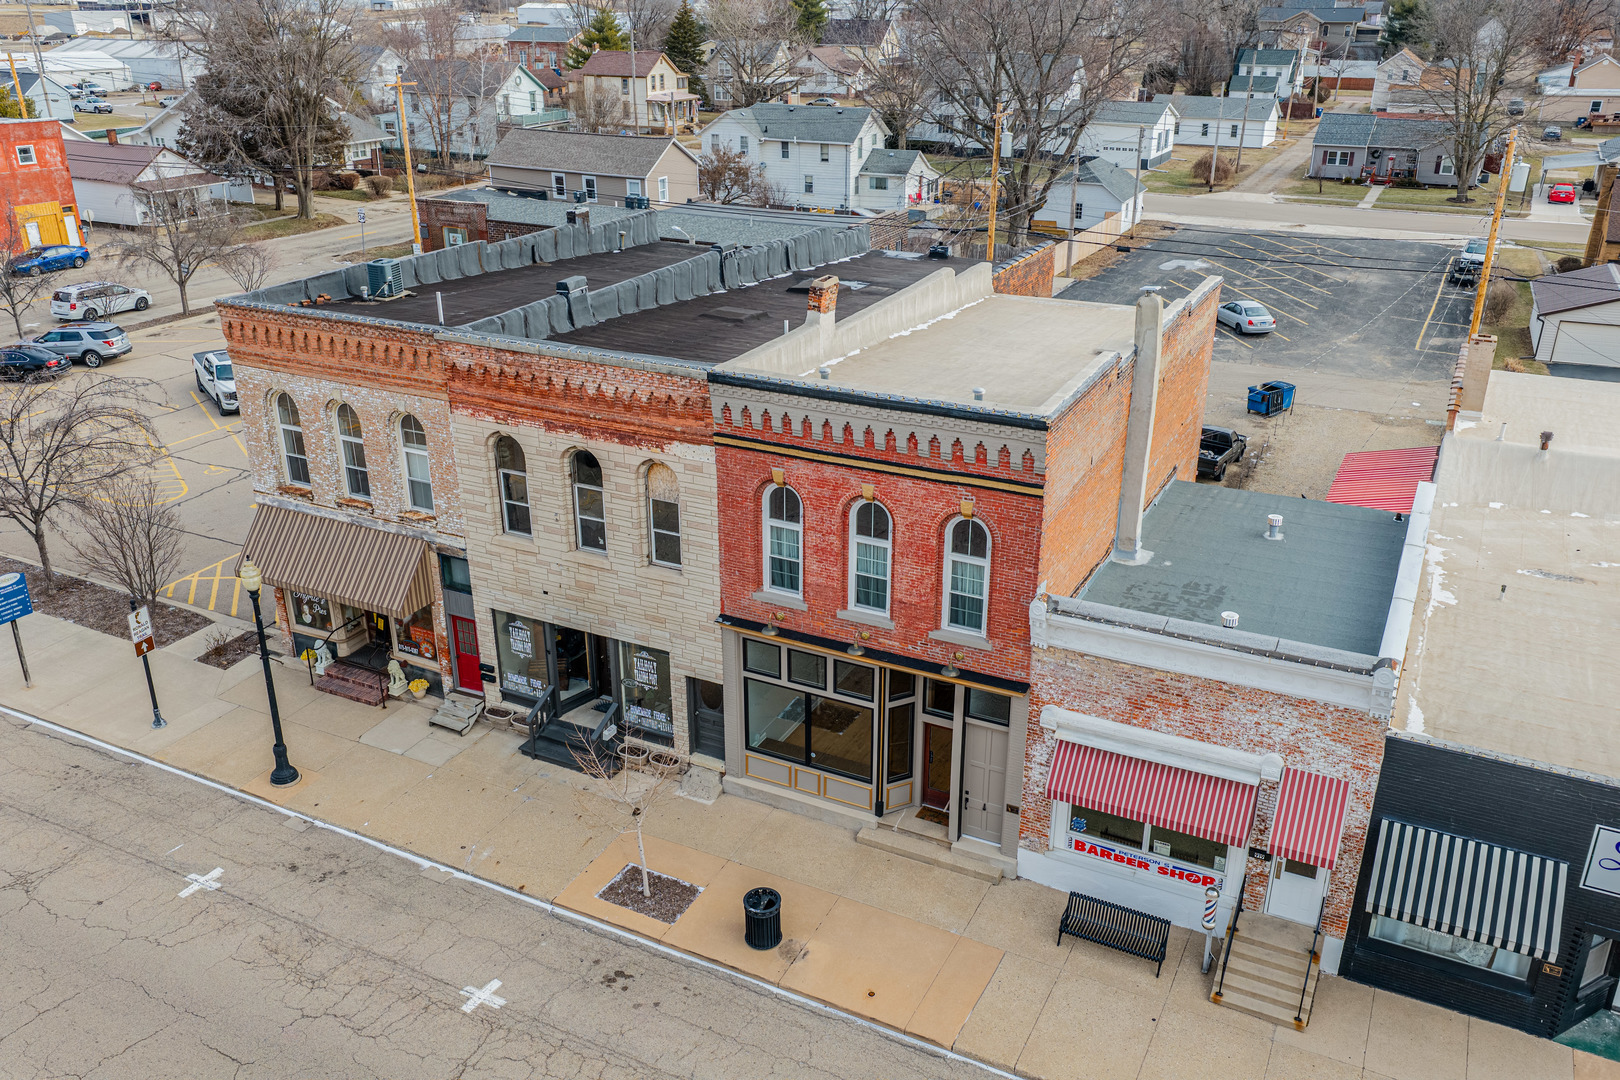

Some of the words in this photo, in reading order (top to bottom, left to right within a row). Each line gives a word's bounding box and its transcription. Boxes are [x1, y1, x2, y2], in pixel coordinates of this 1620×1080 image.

[312, 603, 327, 615] Pies
[133, 620, 148, 632] RONALD
[134, 625, 150, 637] REAGAN
[137, 632, 148, 640] TRAIL
[1074, 839, 1150, 871] BARBER
[1157, 866, 1216, 887] SHOP
